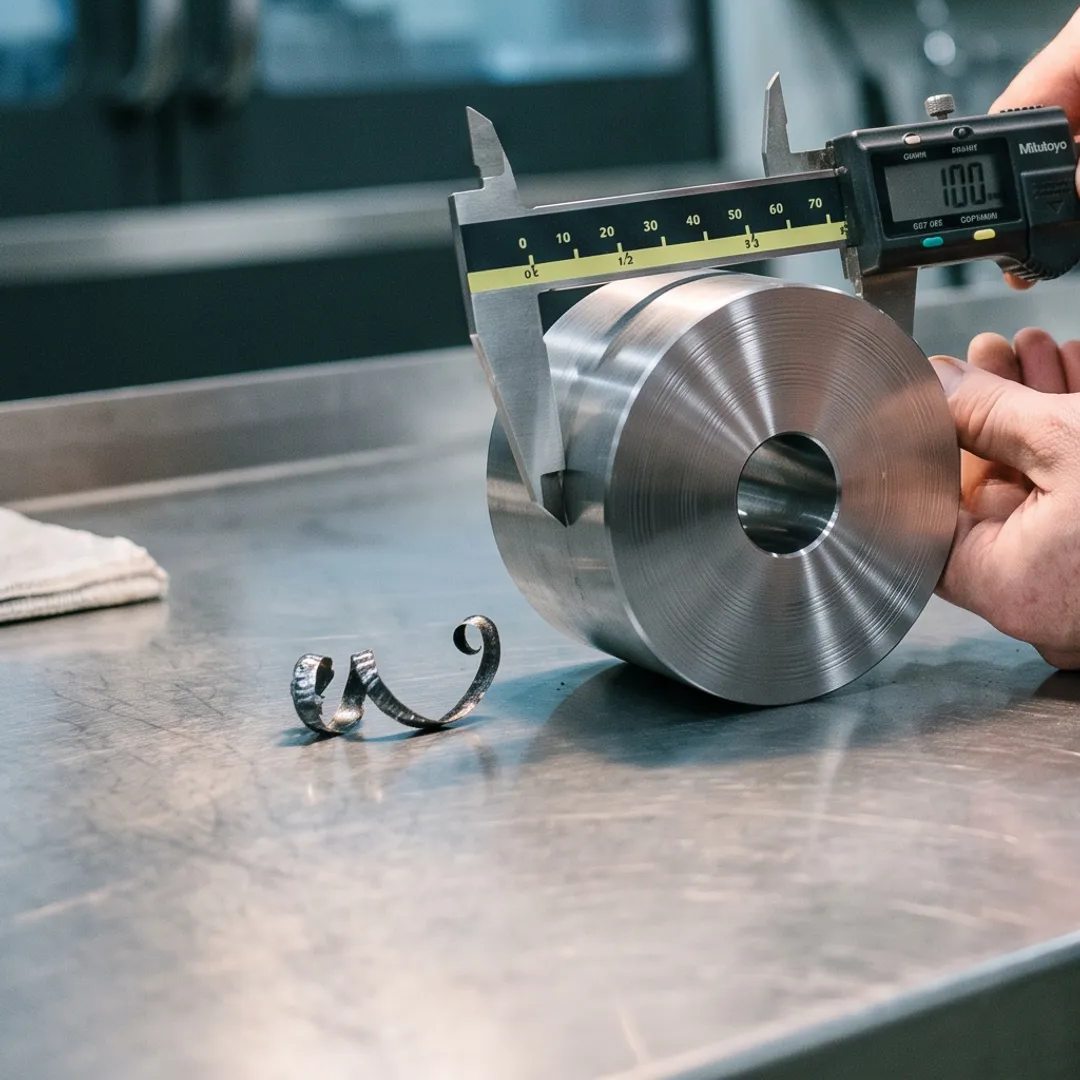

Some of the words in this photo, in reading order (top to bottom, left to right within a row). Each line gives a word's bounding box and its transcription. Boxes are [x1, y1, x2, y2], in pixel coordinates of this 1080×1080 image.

[1018, 140, 1068, 155] Mitutoyo
[941, 161, 987, 209] 100
[518, 237, 528, 249] 0
[555, 231, 571, 244] 10
[599, 225, 615, 238] 20
[643, 219, 658, 232] 30
[686, 214, 701, 226] 40
[728, 208, 743, 220] 50
[769, 202, 784, 215] 60
[808, 197, 823, 209] 70
[618, 252, 634, 266] 1/2
